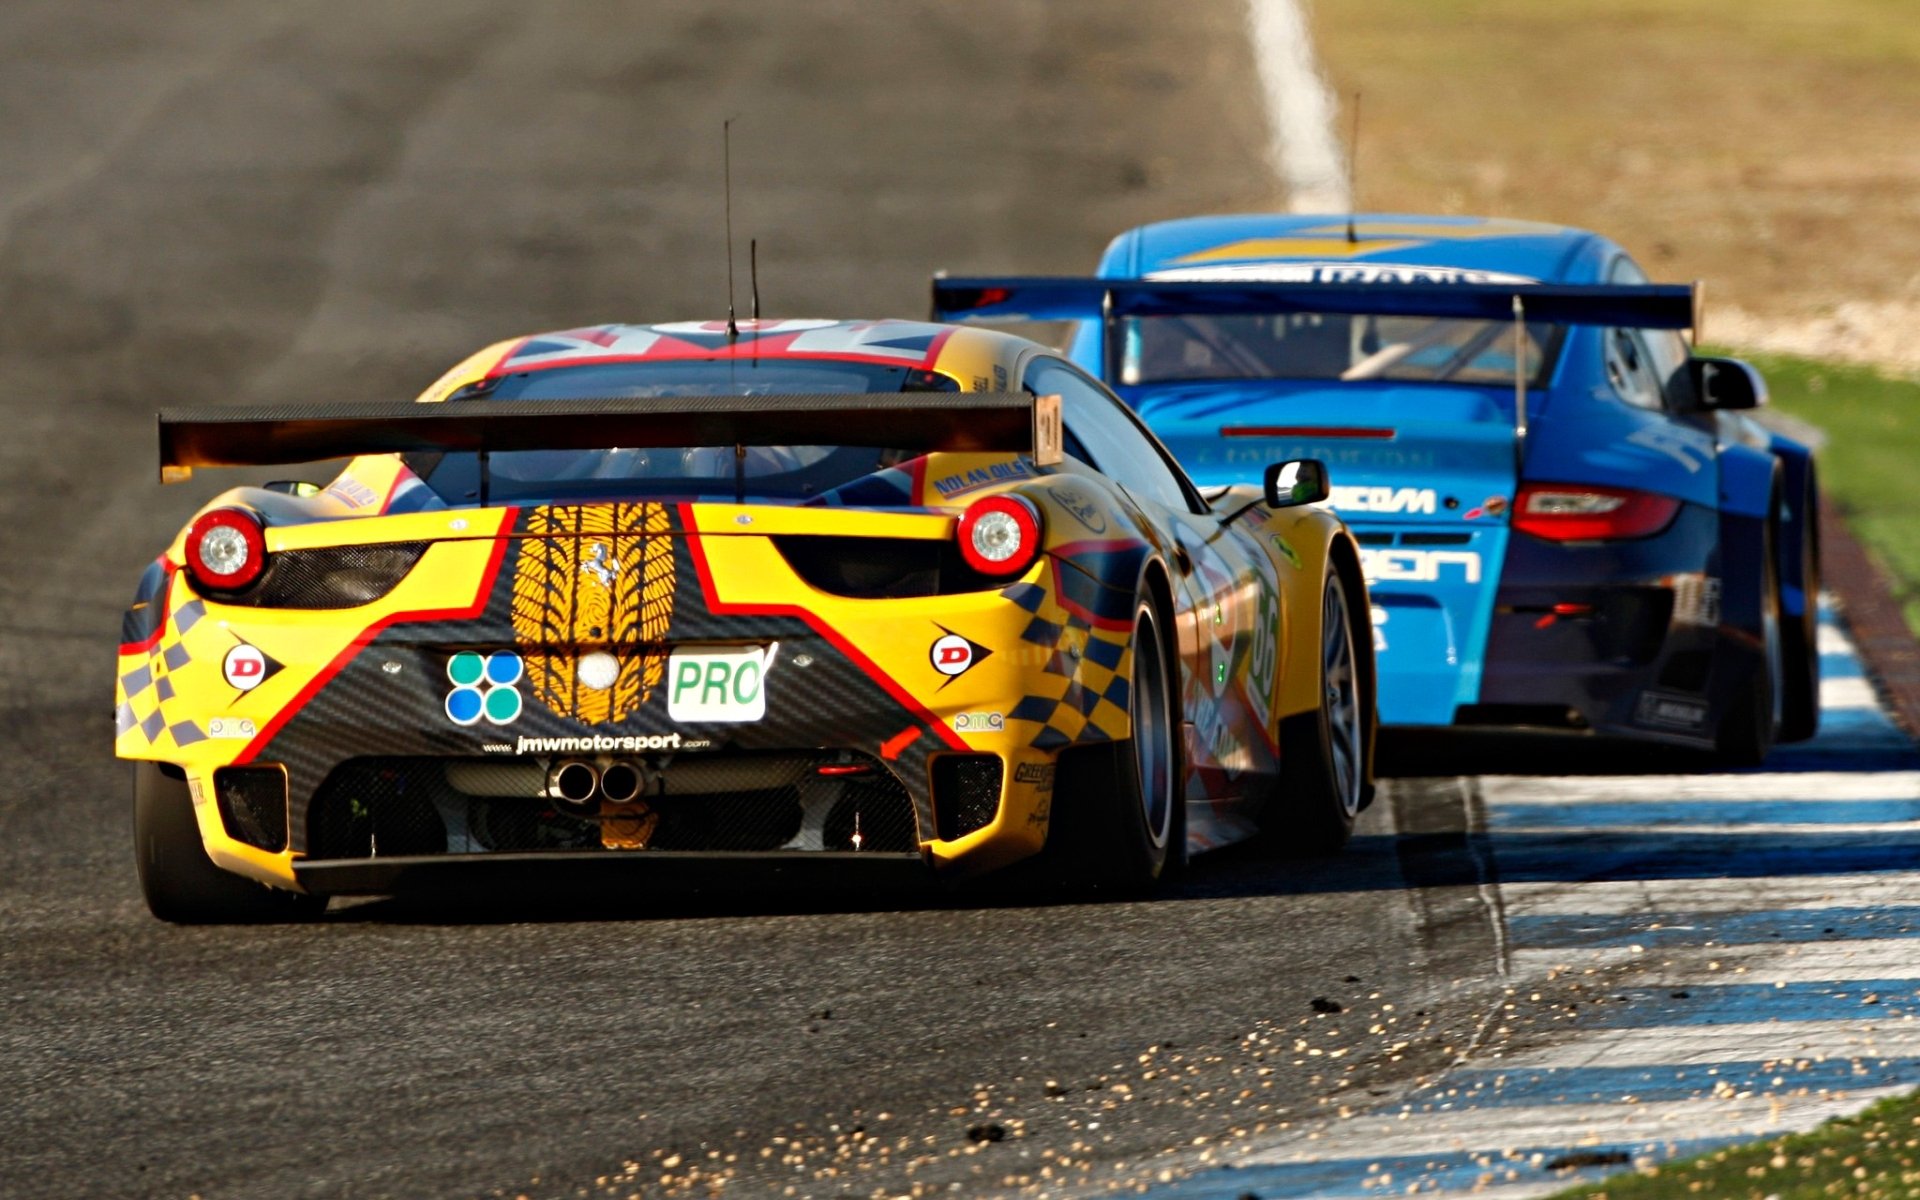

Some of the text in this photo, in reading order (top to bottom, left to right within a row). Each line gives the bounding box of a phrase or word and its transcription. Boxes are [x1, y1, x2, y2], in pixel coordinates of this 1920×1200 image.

[934, 459, 1027, 494] NOLAN OILS
[938, 646, 969, 664] D
[231, 658, 262, 677] D
[672, 660, 760, 705] PRO
[516, 732, 681, 755] jmwmotorsport
